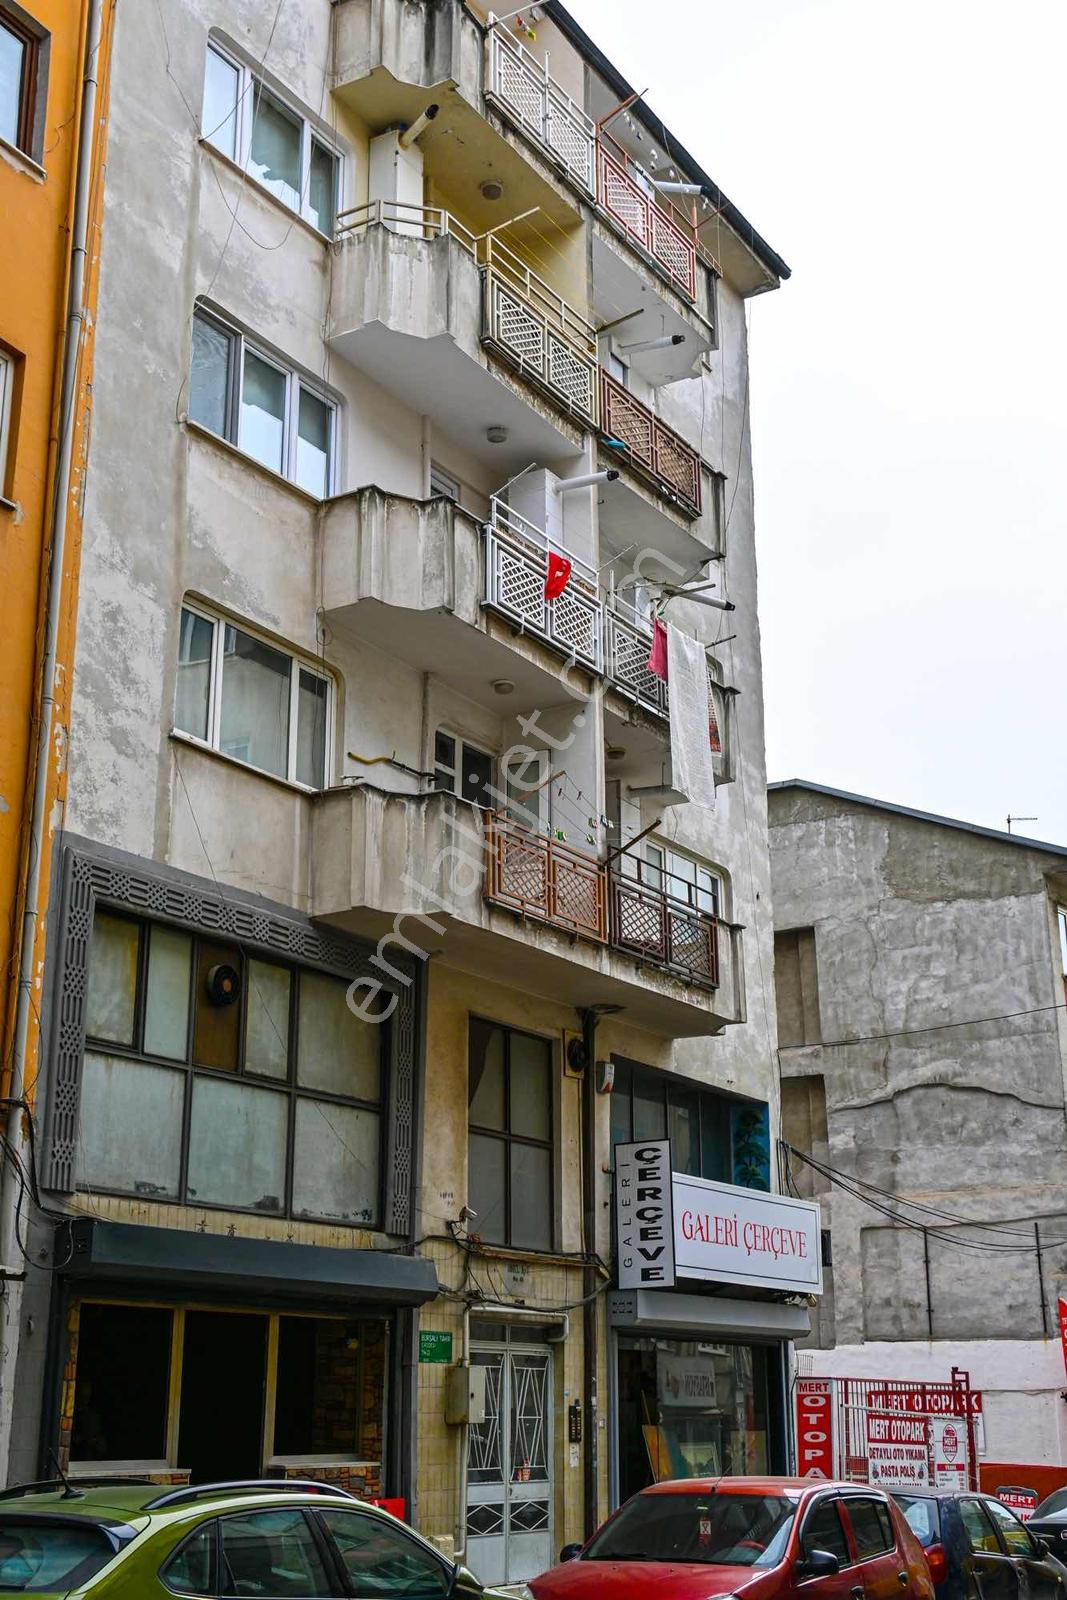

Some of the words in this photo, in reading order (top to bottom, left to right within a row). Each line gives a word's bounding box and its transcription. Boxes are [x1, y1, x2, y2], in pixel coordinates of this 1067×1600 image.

[635, 1147, 665, 1282] ÇERÇEVE
[682, 1211, 738, 1247] GALERİ
[743, 1223, 807, 1260] ÇERÇEVE
[799, 1382, 829, 1393] MERT
[869, 1419, 889, 1440] MERT
[891, 1421, 925, 1442] OTOPARK
[869, 1447, 892, 1460] DETAYLI
[893, 1448, 904, 1460] OTO
[905, 1448, 926, 1461] YIKAMA
[880, 1464, 898, 1478] PASTA
[900, 1464, 916, 1481] POLİŞ
[999, 1493, 1034, 1504] MERT
